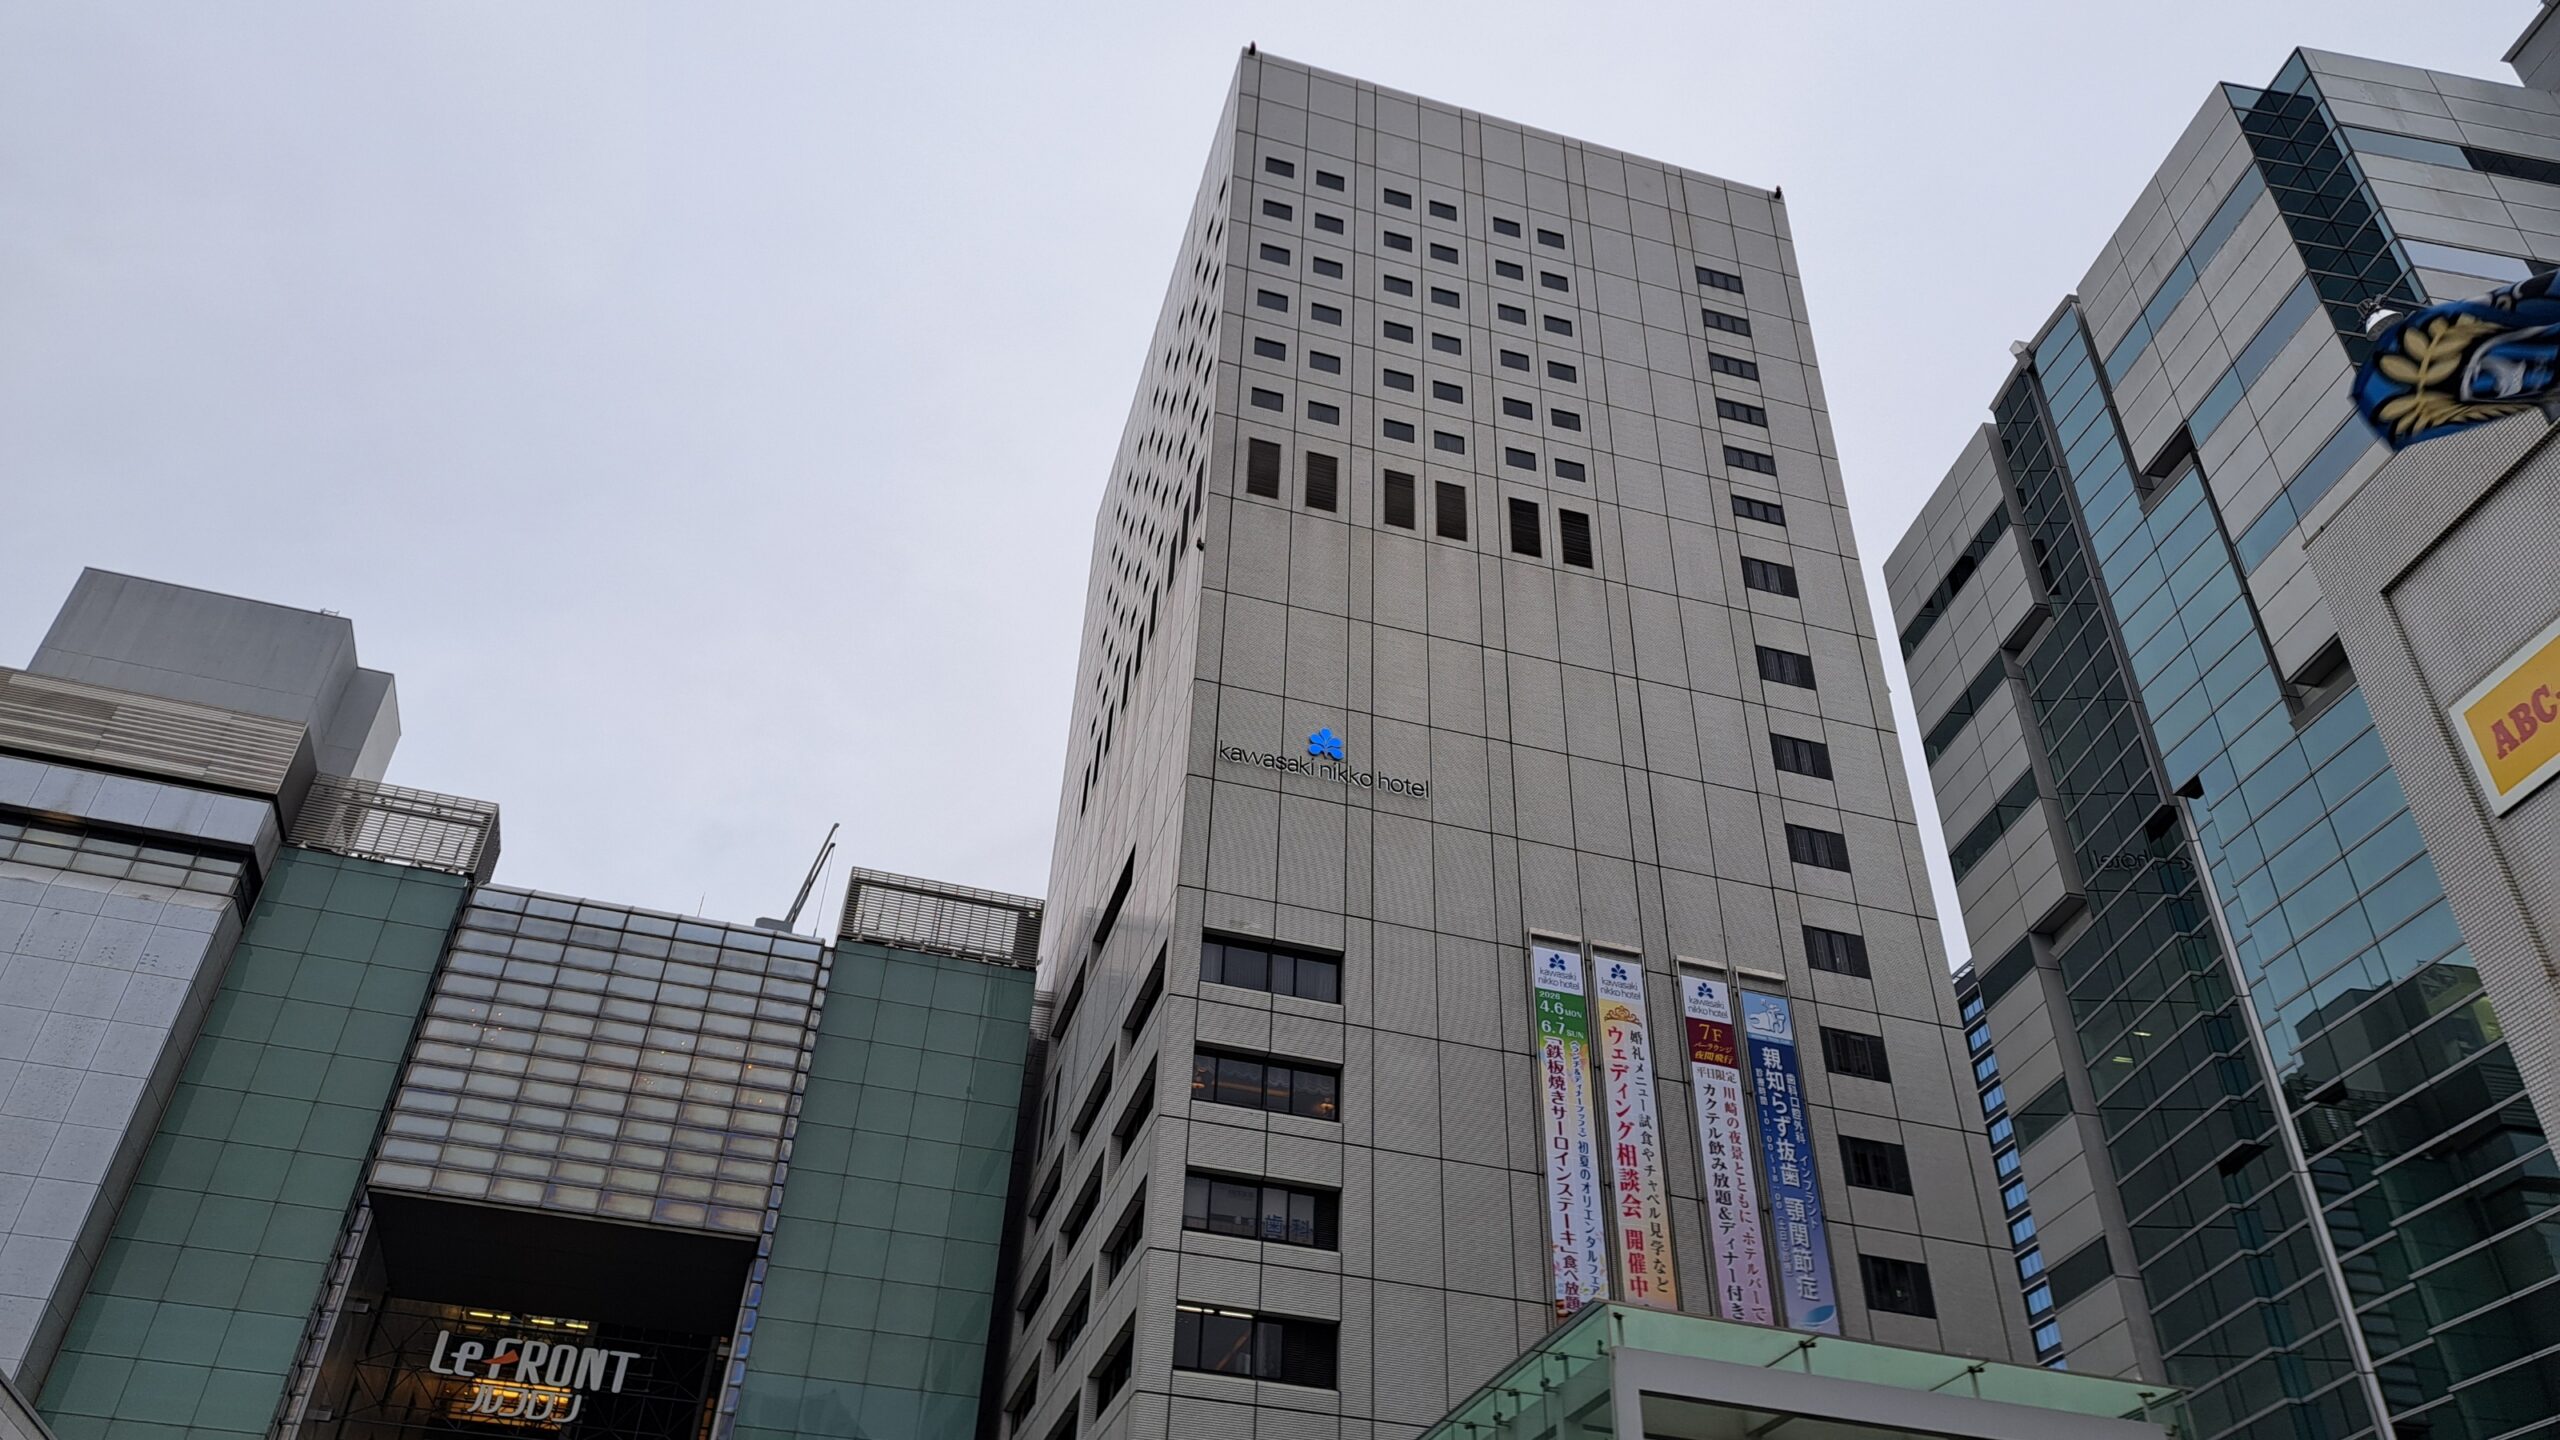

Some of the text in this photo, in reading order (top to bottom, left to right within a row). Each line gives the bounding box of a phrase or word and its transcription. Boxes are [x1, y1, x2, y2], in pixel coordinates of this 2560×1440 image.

[2491, 684, 2560, 760] ABC
[1218, 740, 1430, 798] kawasaki nikko hotel
[1538, 976, 1580, 991] nikko hotel
[1540, 968, 1577, 981] kawasaki
[1601, 977, 1638, 990] kawasaki
[1600, 986, 1641, 1001] nikko hotel
[1688, 996, 1725, 1009] kawasaki
[1540, 1000, 1582, 1018] 4.6 MON
[1688, 1005, 1729, 1018] nikko hotel
[1541, 1020, 1584, 1039] 6.7 SUN
[1699, 1024, 1723, 1042] 7F
[1696, 1067, 1737, 1083] 平日限定
[1762, 1046, 1800, 1188] 親知らず抜歯
[1630, 1030, 1668, 1293] 婚礼メニュー試食やチャペル見学など
[1703, 1083, 1745, 1320] カクテル飲み放題&ディナー付き
[1625, 1229, 1649, 1298] 開催中
[467, 1384, 582, 1423] ルフロン
